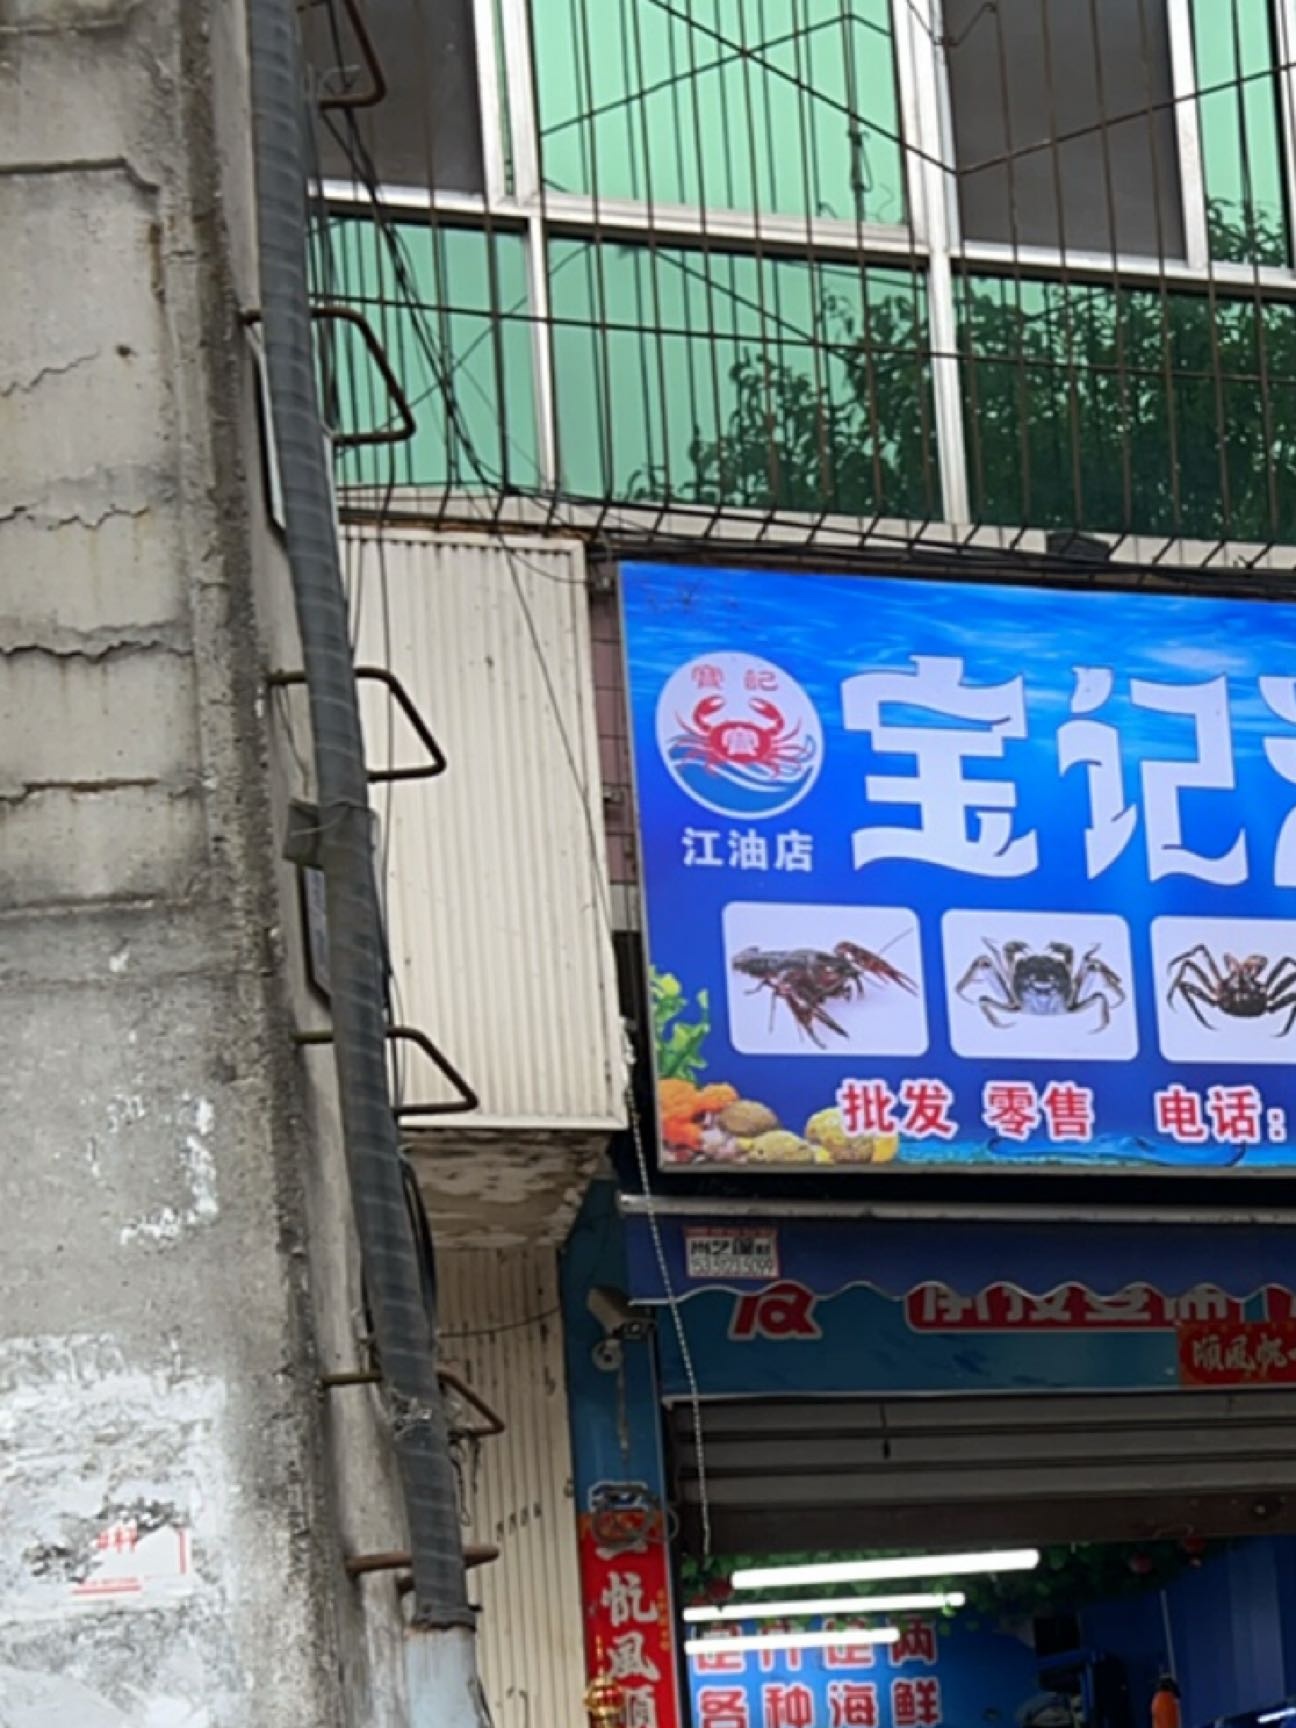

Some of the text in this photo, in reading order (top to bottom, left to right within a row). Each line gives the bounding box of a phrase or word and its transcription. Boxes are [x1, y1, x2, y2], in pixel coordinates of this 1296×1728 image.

[681, 826, 814, 873] 江油店
[838, 1079, 957, 1138] 批发
[983, 1084, 1096, 1140] 零售
